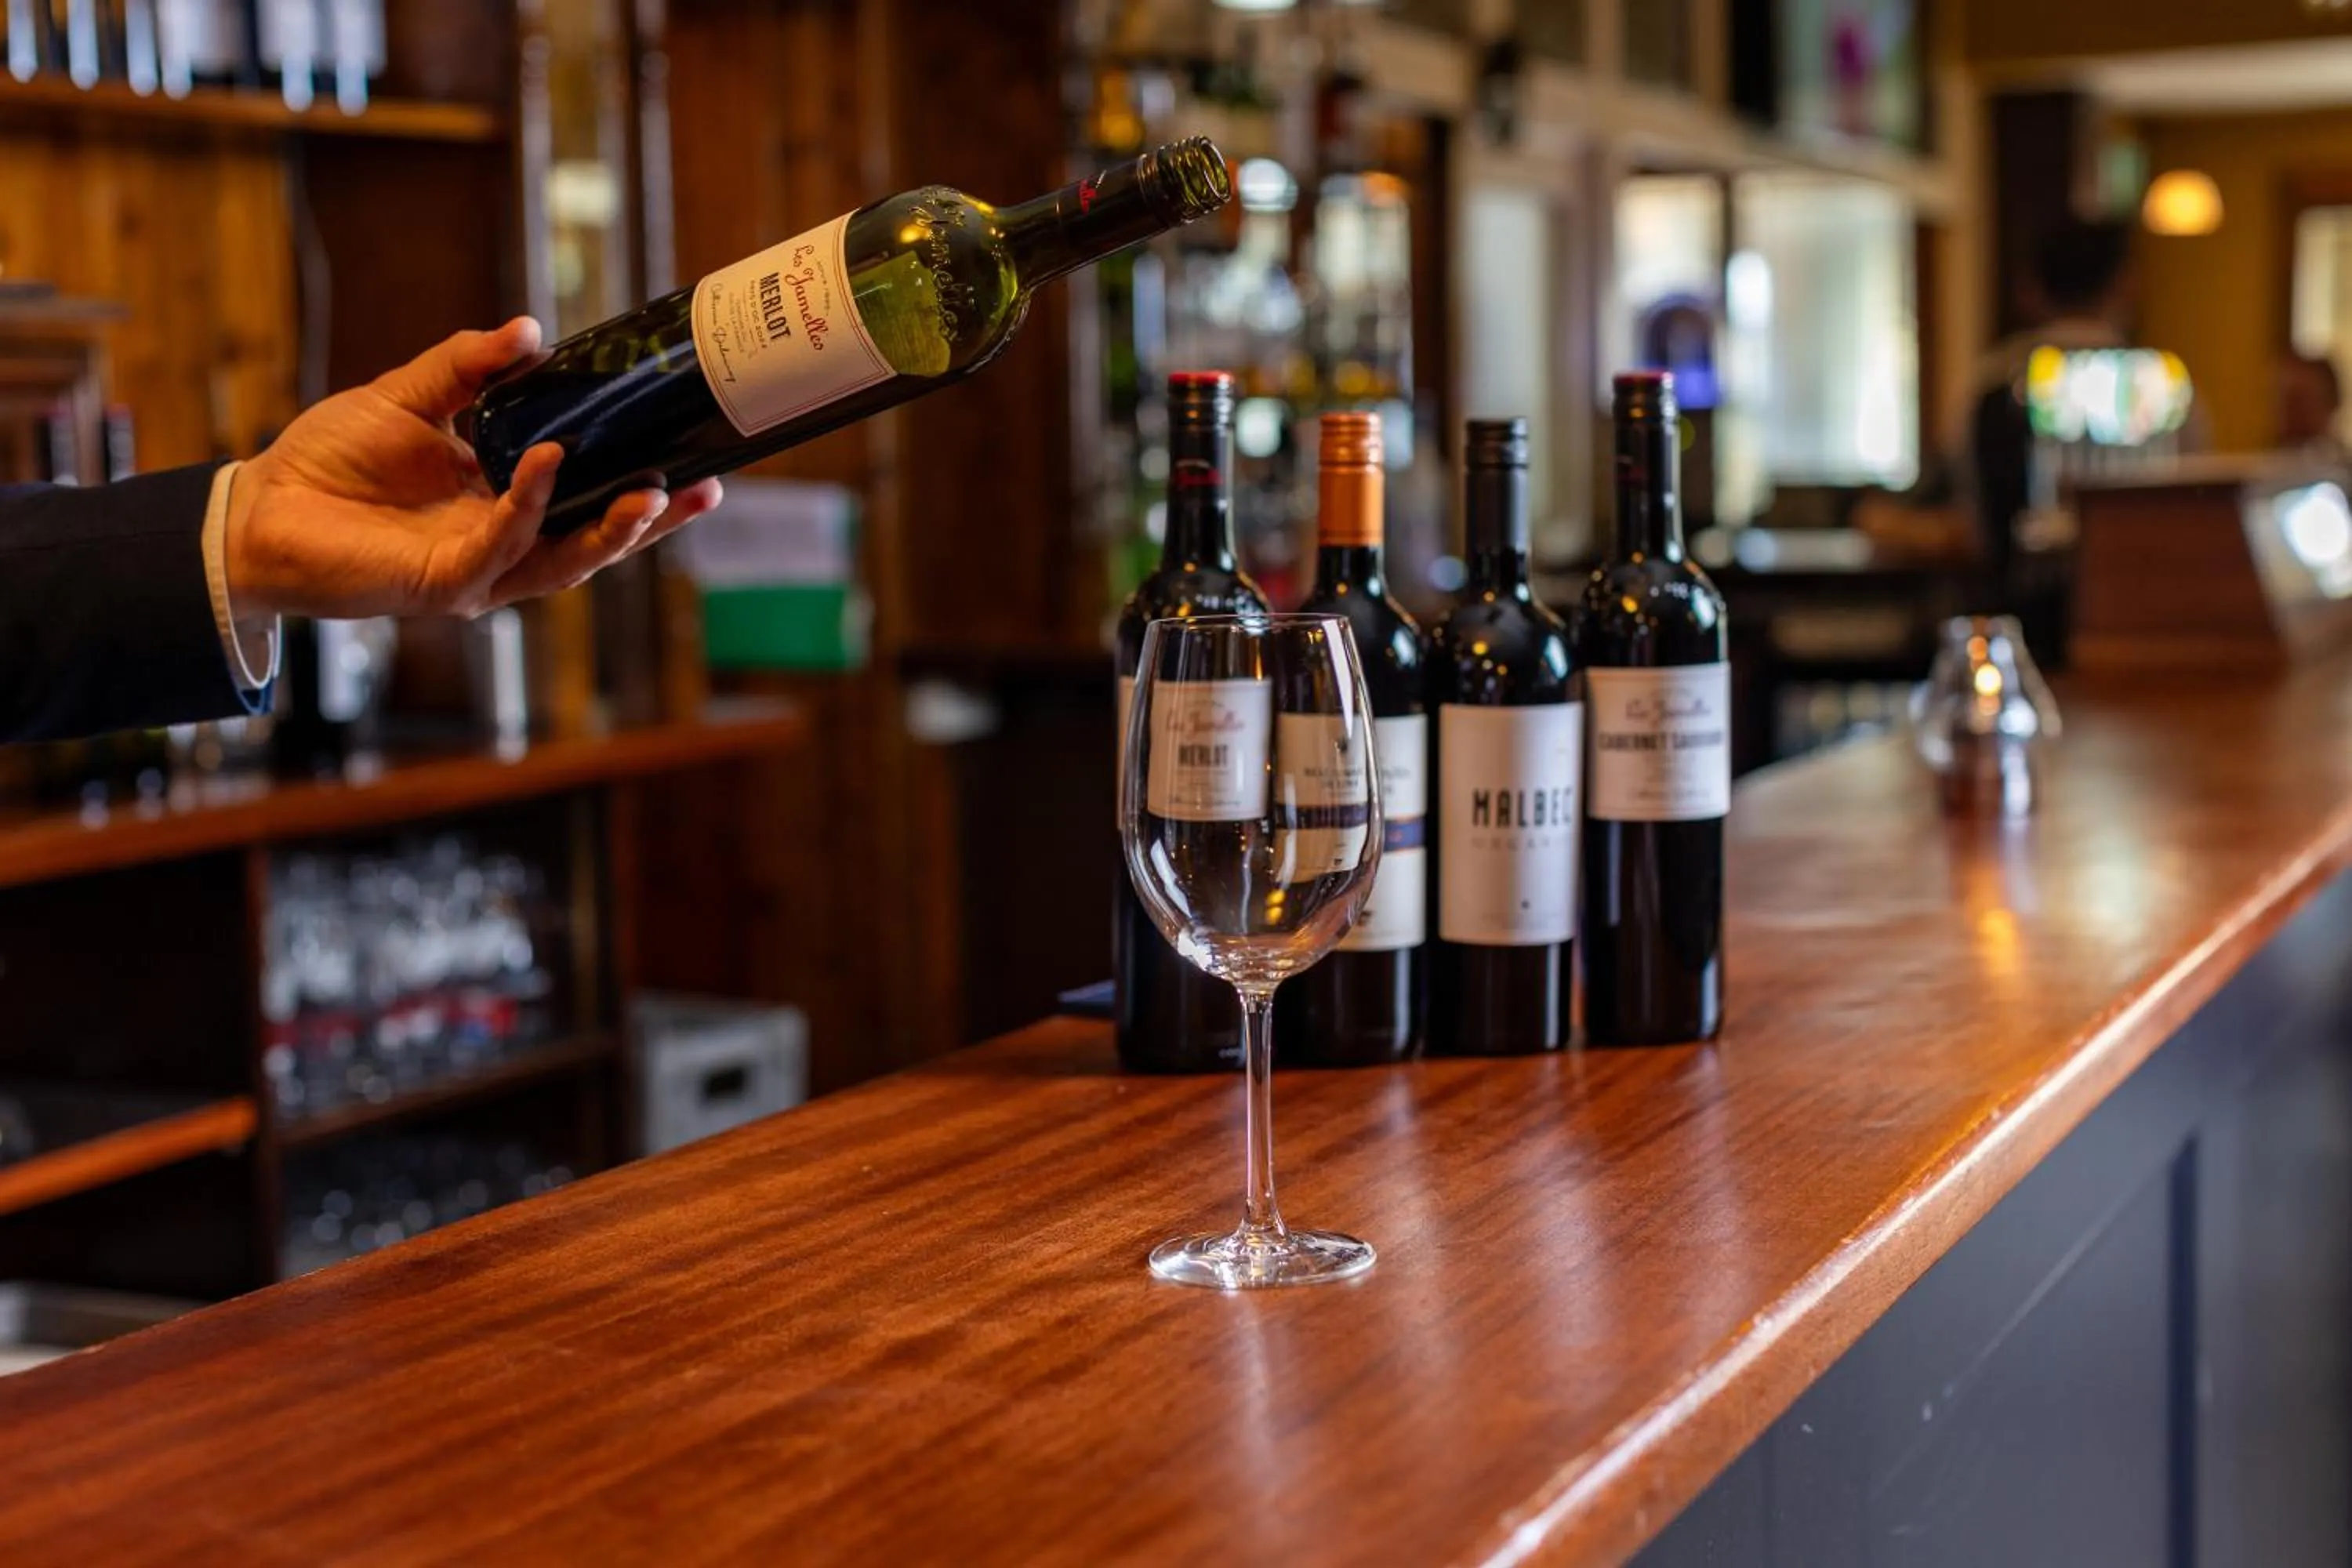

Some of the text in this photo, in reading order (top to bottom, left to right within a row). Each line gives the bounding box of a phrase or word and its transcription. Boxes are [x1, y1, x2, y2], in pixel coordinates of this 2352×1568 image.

[793, 245, 815, 268] Les
[760, 271, 792, 340] MERLOT
[784, 267, 829, 351] Jamelles
[1472, 788, 1572, 828] MALBEC
